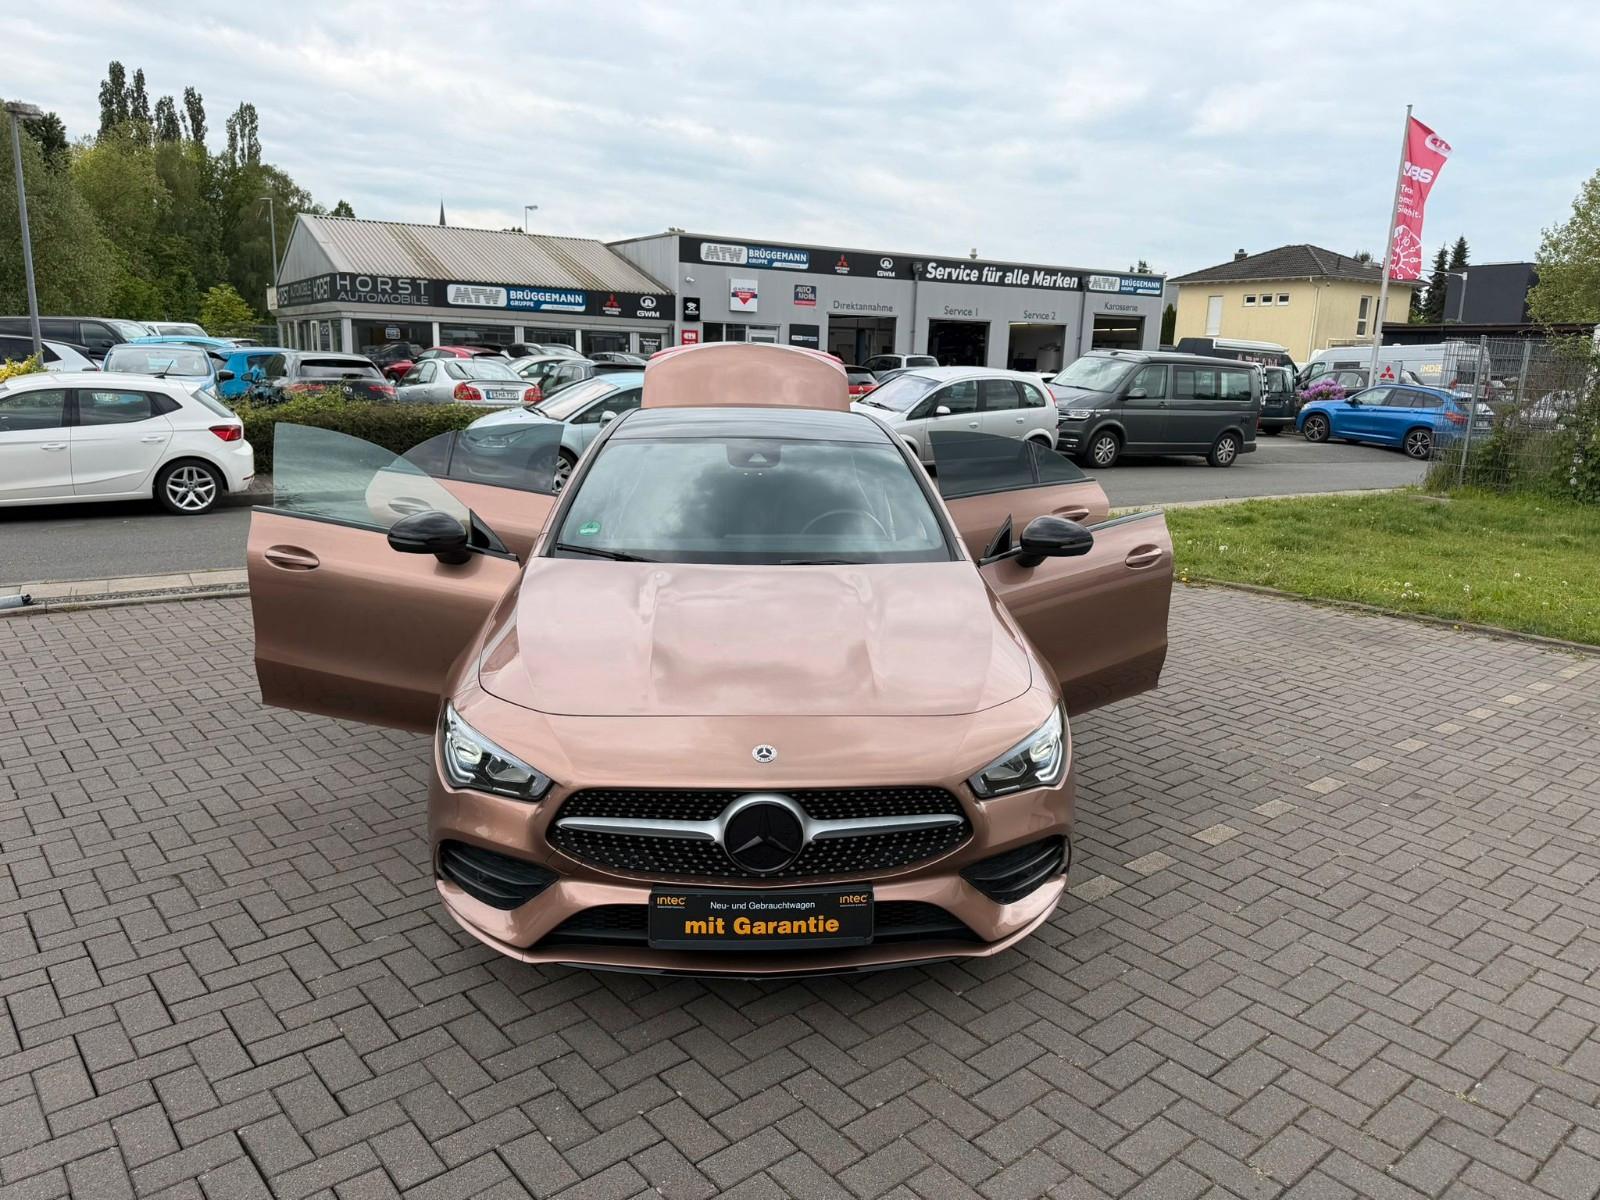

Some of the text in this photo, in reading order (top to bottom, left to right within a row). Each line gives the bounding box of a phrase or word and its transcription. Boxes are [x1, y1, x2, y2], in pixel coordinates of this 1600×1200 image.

[703, 245, 744, 263] MTW
[748, 248, 807, 262] BRÜGGEMANN
[926, 262, 1078, 289] Service für alle Marken
[336, 274, 429, 295] HORST
[1121, 279, 1160, 289] BRÜGGEMANN
[337, 291, 429, 305] AUTOMOBILE
[452, 287, 502, 305] MTW
[509, 289, 583, 304] BRÜGGEMANN
[833, 300, 893, 312] Direktannahme
[944, 305, 973, 317] Service
[1104, 302, 1138, 312] Karosserie
[636, 310, 660, 318] GWM
[1023, 310, 1056, 320] Service 2
[656, 896, 685, 905] intec
[839, 895, 868, 904] intec
[710, 901, 816, 912] Neu- und Gebrauchtwagen
[685, 915, 840, 935] mit Garantie
